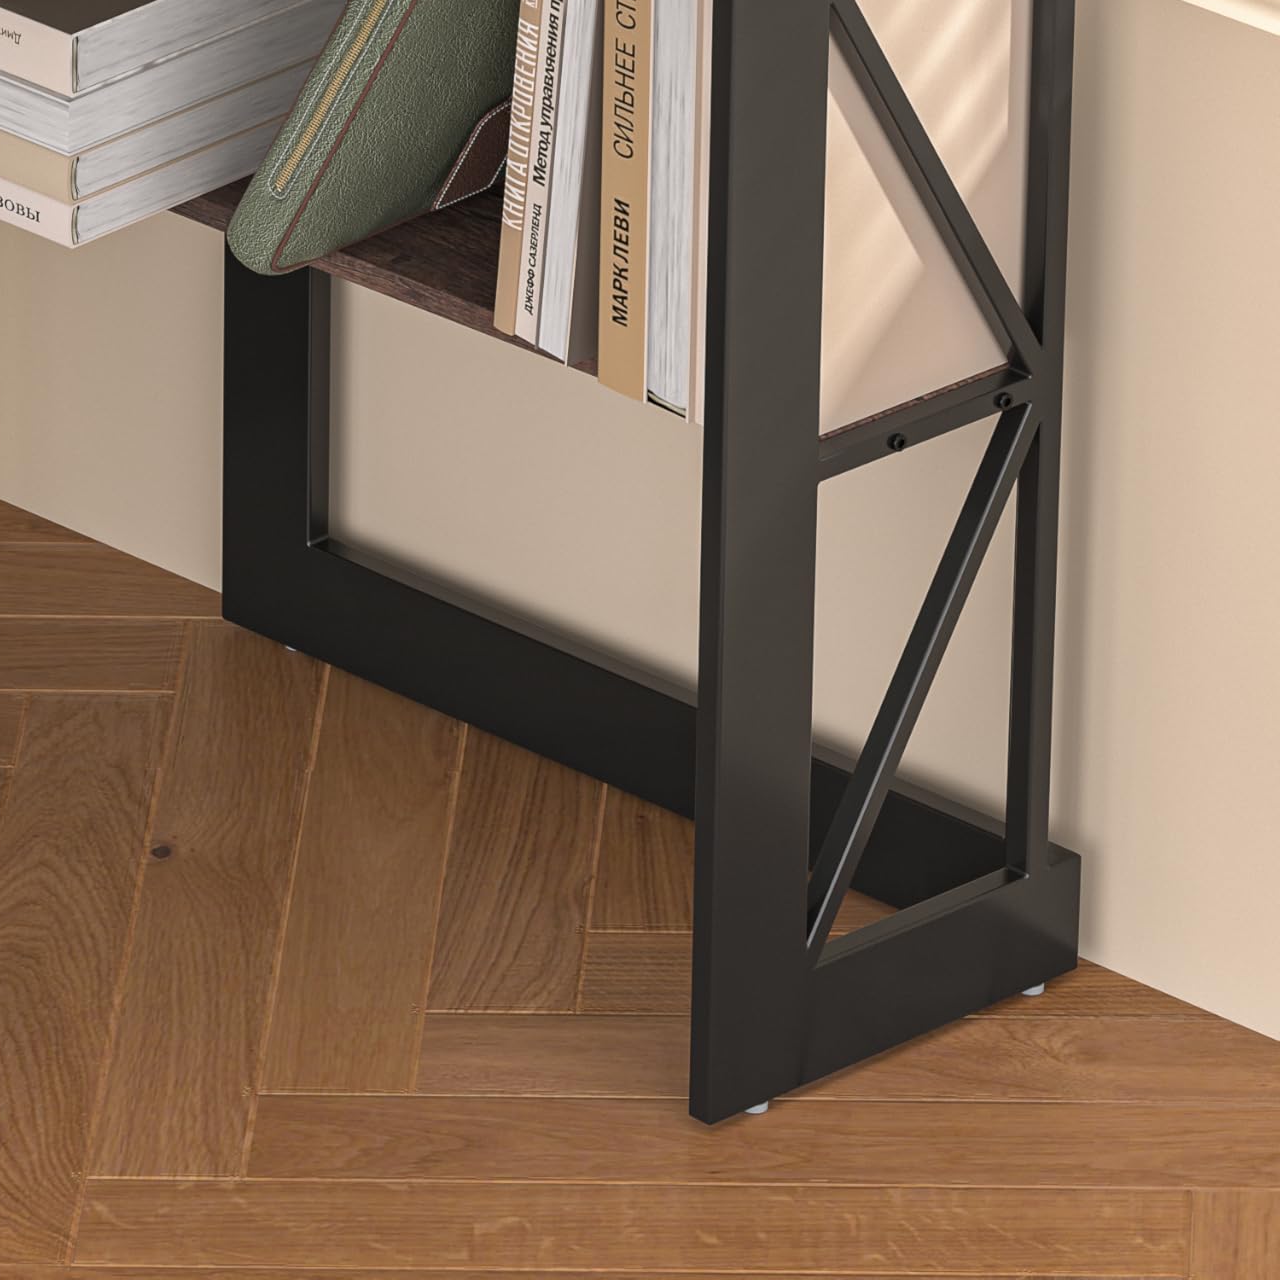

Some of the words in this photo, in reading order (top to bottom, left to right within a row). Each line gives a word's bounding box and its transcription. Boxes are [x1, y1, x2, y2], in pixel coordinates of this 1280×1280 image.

[508, 17, 540, 158] ОТКРОВЕНИЯ
[613, 37, 636, 159] СИЛЬНЕЕ
[532, 130, 552, 187] Метод
[501, 158, 528, 231] КНИГА
[528, 203, 543, 268] САЗЕРЛЕНД
[613, 197, 631, 264] ЛЕВИ
[524, 269, 536, 316] ДЖЕФФ
[612, 263, 629, 327] МАРК
